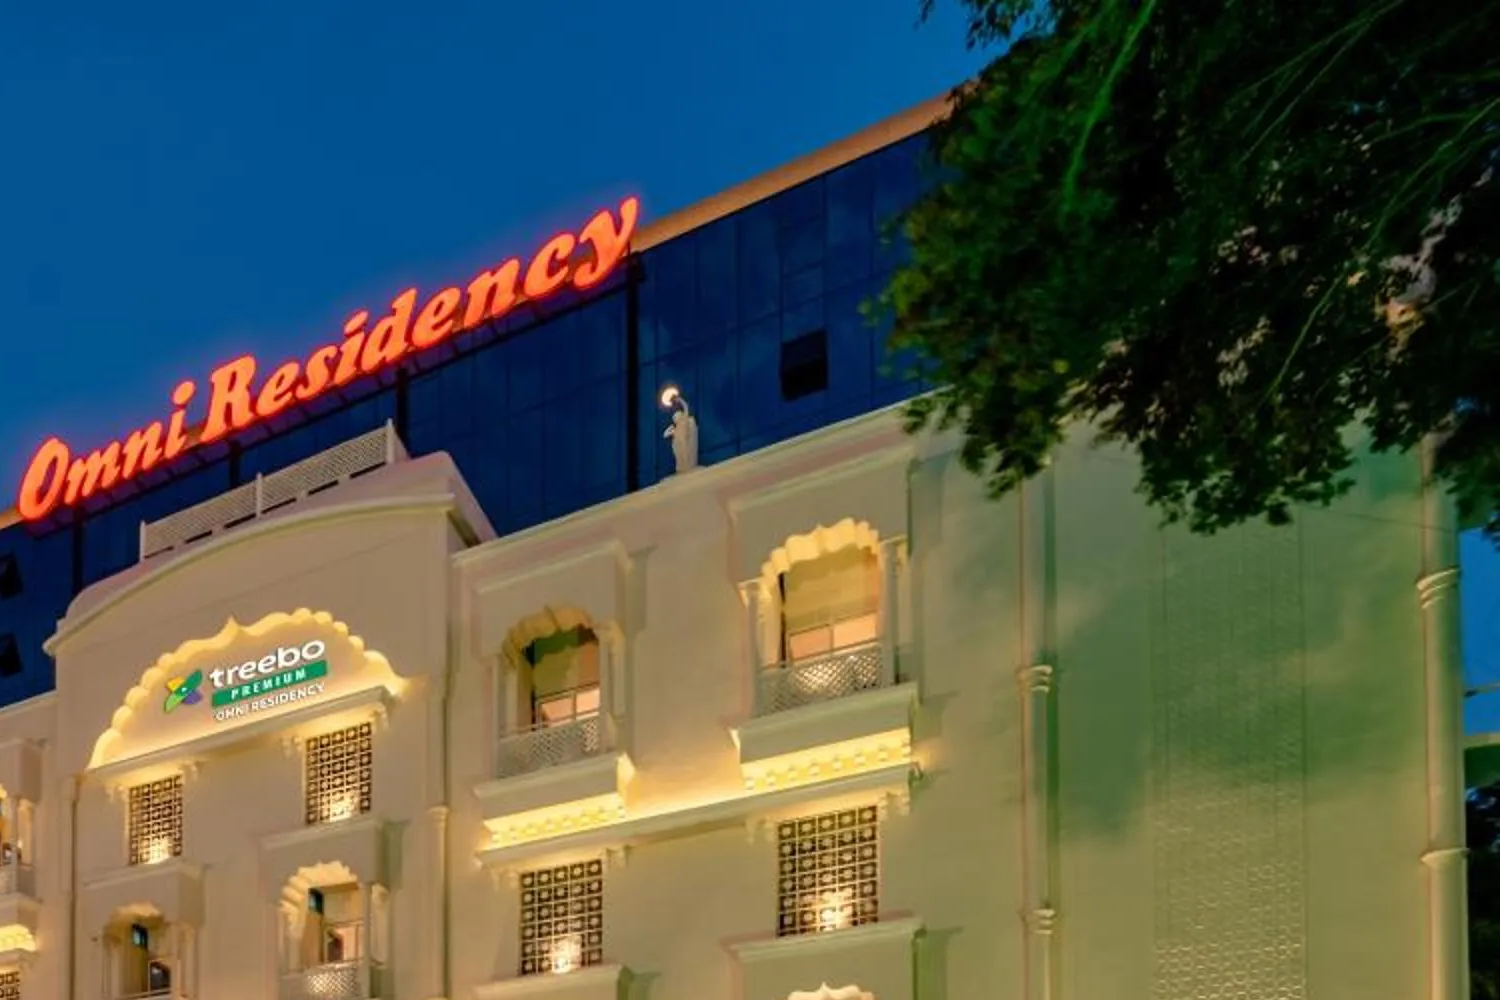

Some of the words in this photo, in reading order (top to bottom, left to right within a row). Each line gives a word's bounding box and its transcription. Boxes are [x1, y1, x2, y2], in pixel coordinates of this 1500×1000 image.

[18, 379, 196, 522] Omni
[200, 196, 640, 445] Residency
[210, 639, 326, 688] treebo
[231, 669, 306, 699] PREMIUM
[252, 682, 326, 711] RESIDENCY
